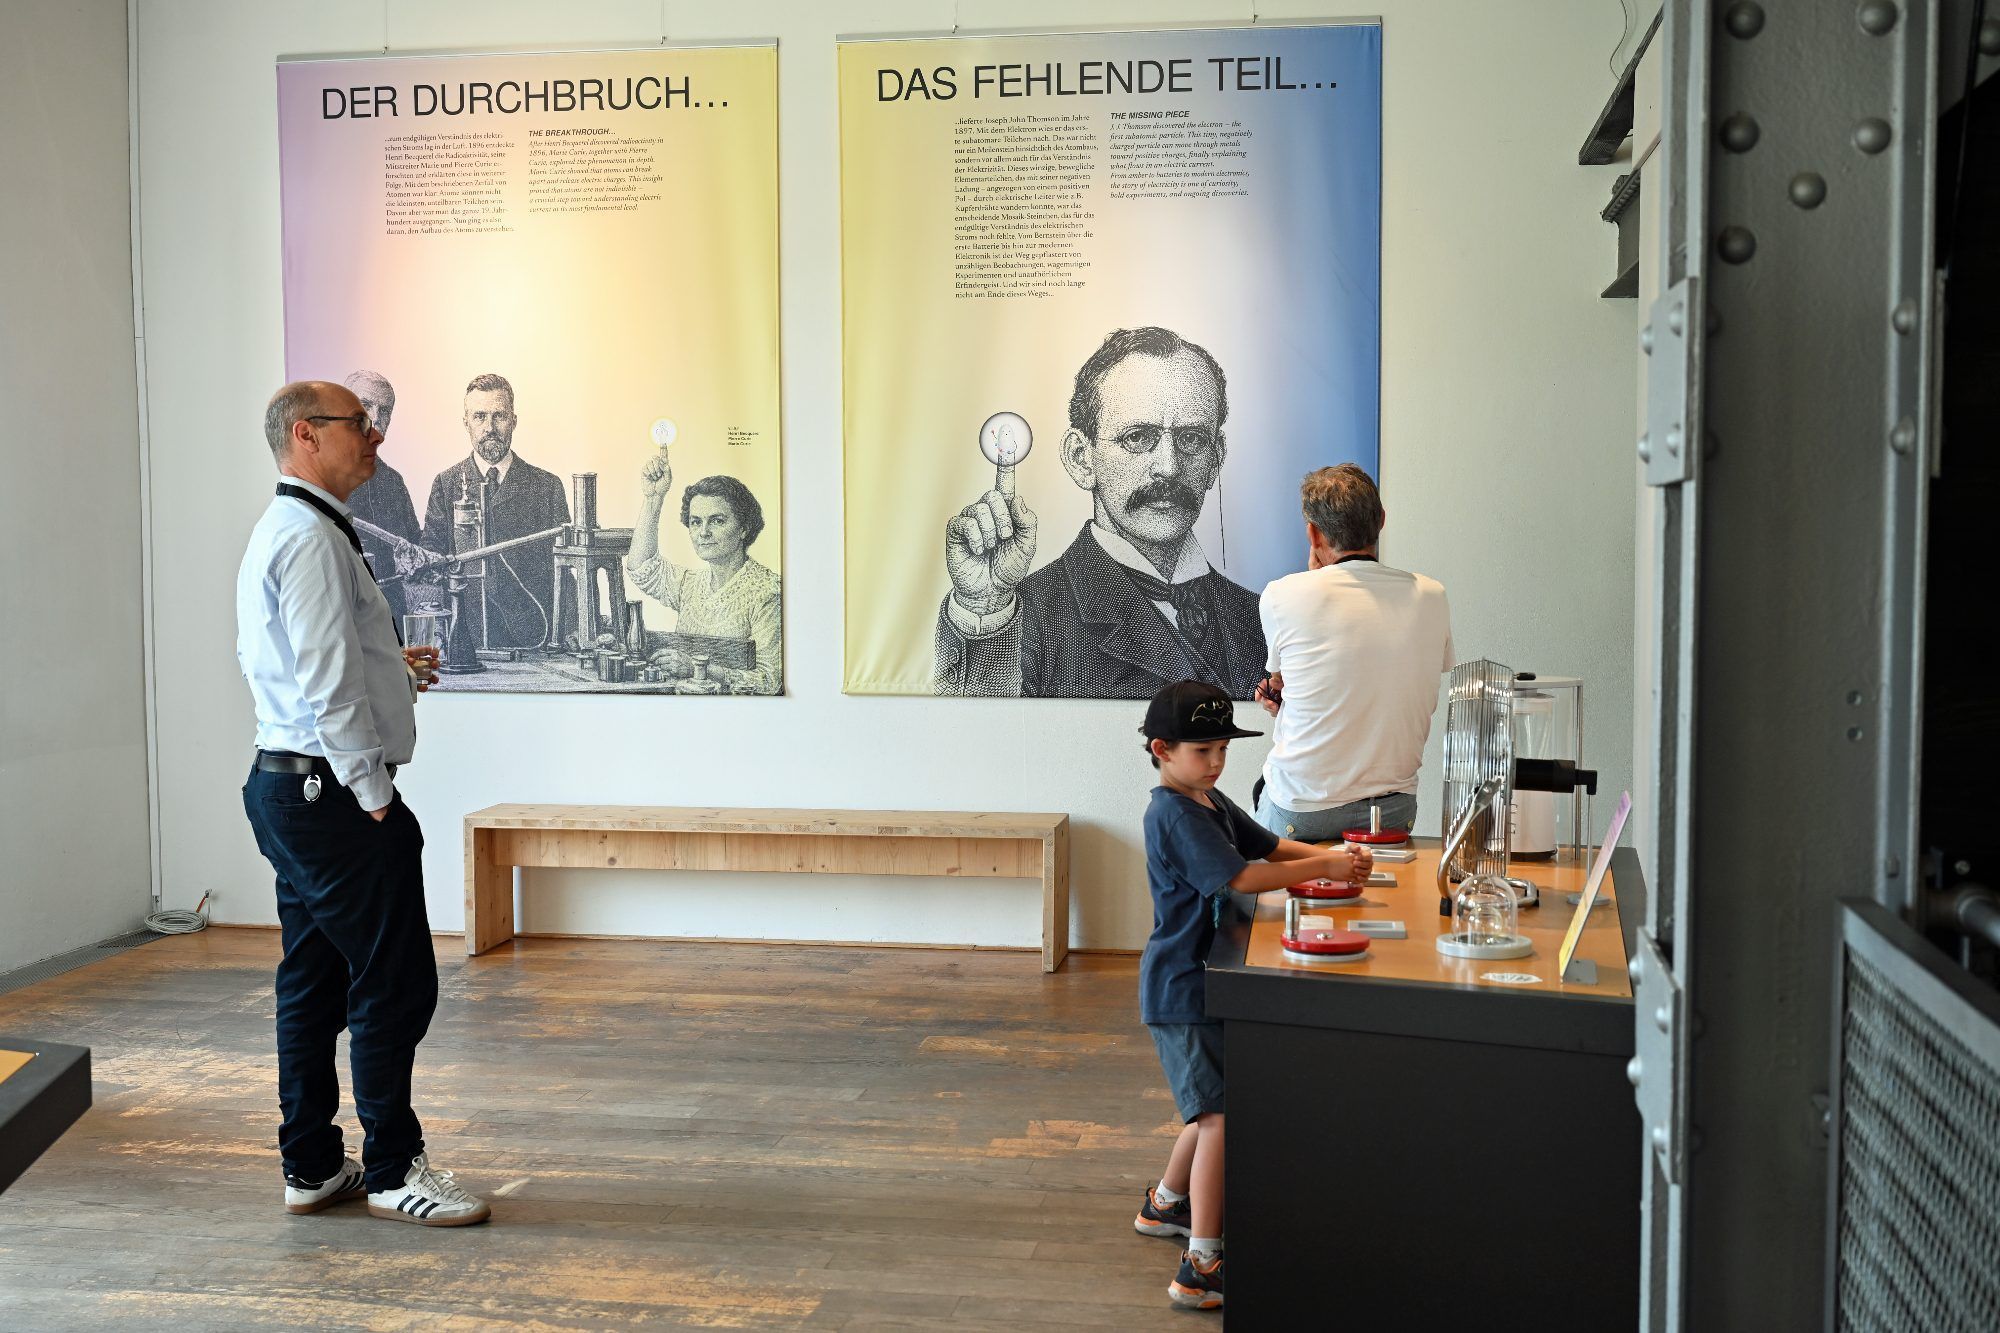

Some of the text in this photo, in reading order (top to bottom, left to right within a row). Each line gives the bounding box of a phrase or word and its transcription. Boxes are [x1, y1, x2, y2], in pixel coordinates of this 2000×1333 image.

[322, 75, 729, 119] DER DURCHBRUCH...
[878, 56, 1338, 102] DAS FEHLENDE TEIL...
